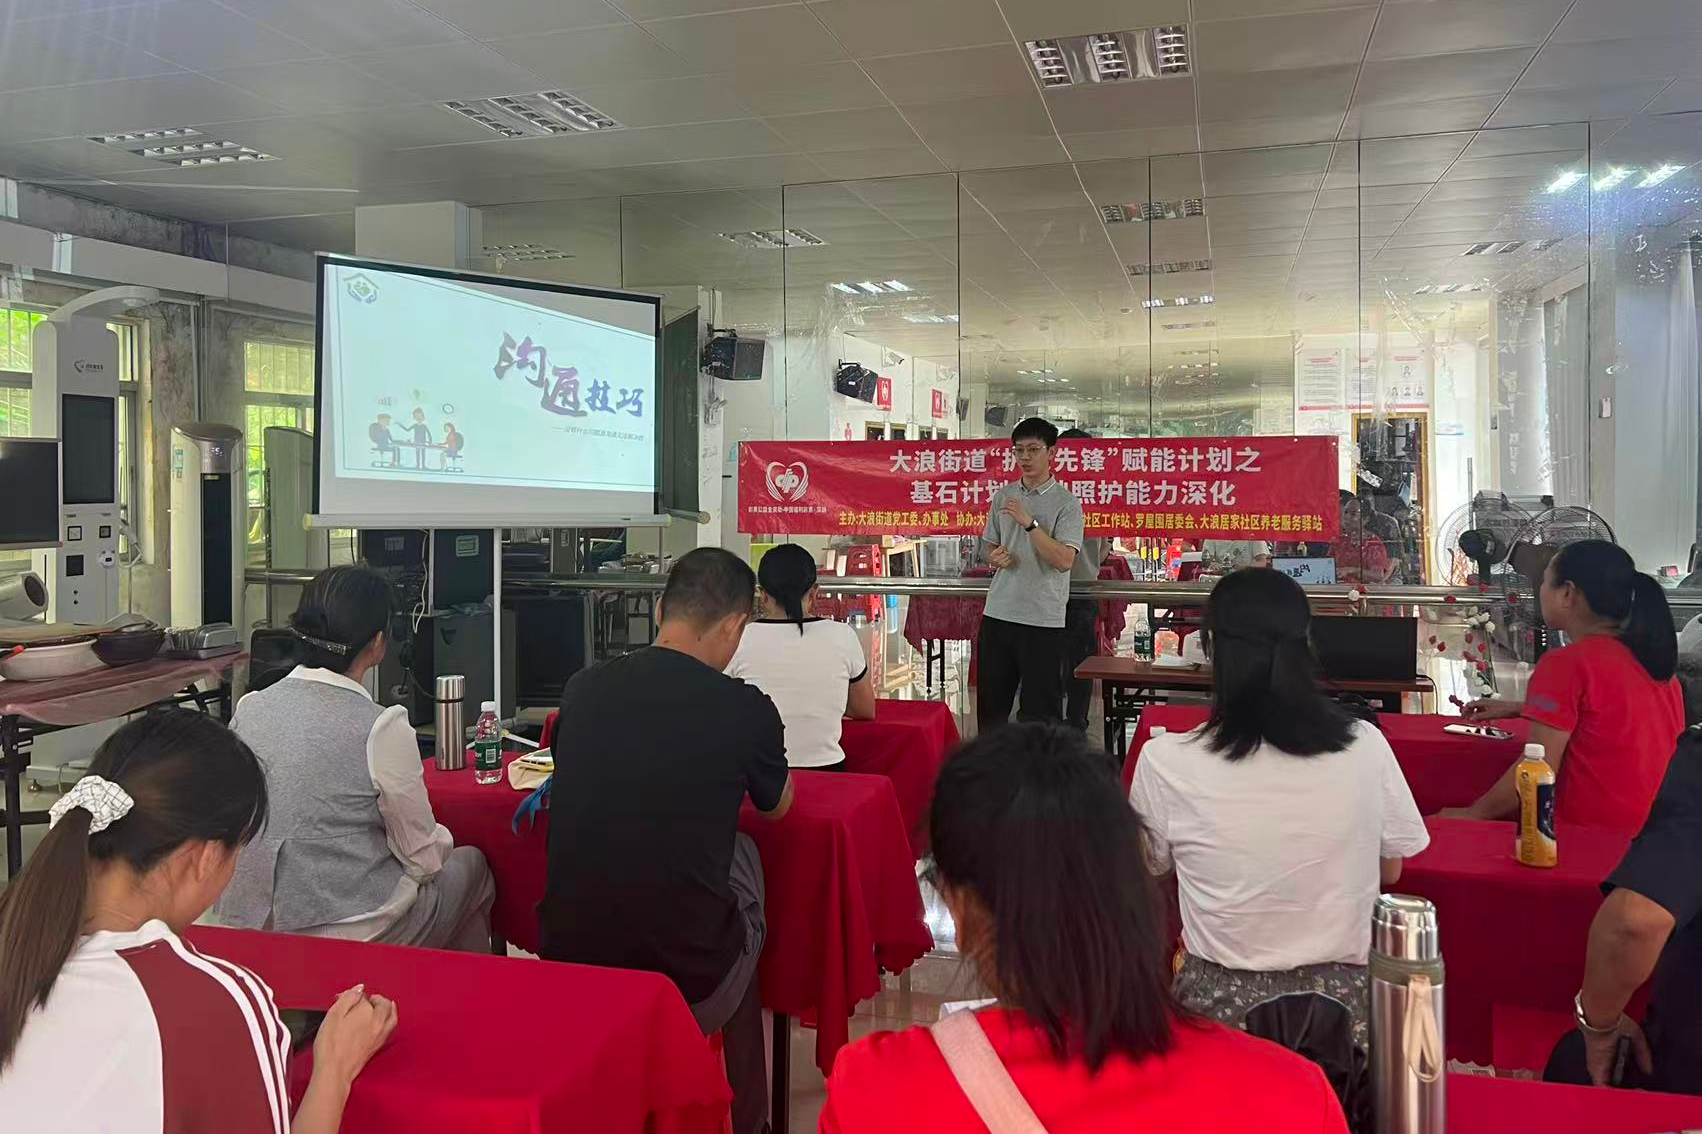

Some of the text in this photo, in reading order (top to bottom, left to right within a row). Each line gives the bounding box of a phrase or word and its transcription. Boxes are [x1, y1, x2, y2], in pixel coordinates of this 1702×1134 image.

[889, 446, 1262, 474] 大浪街道“护先锋”赋能计划之
